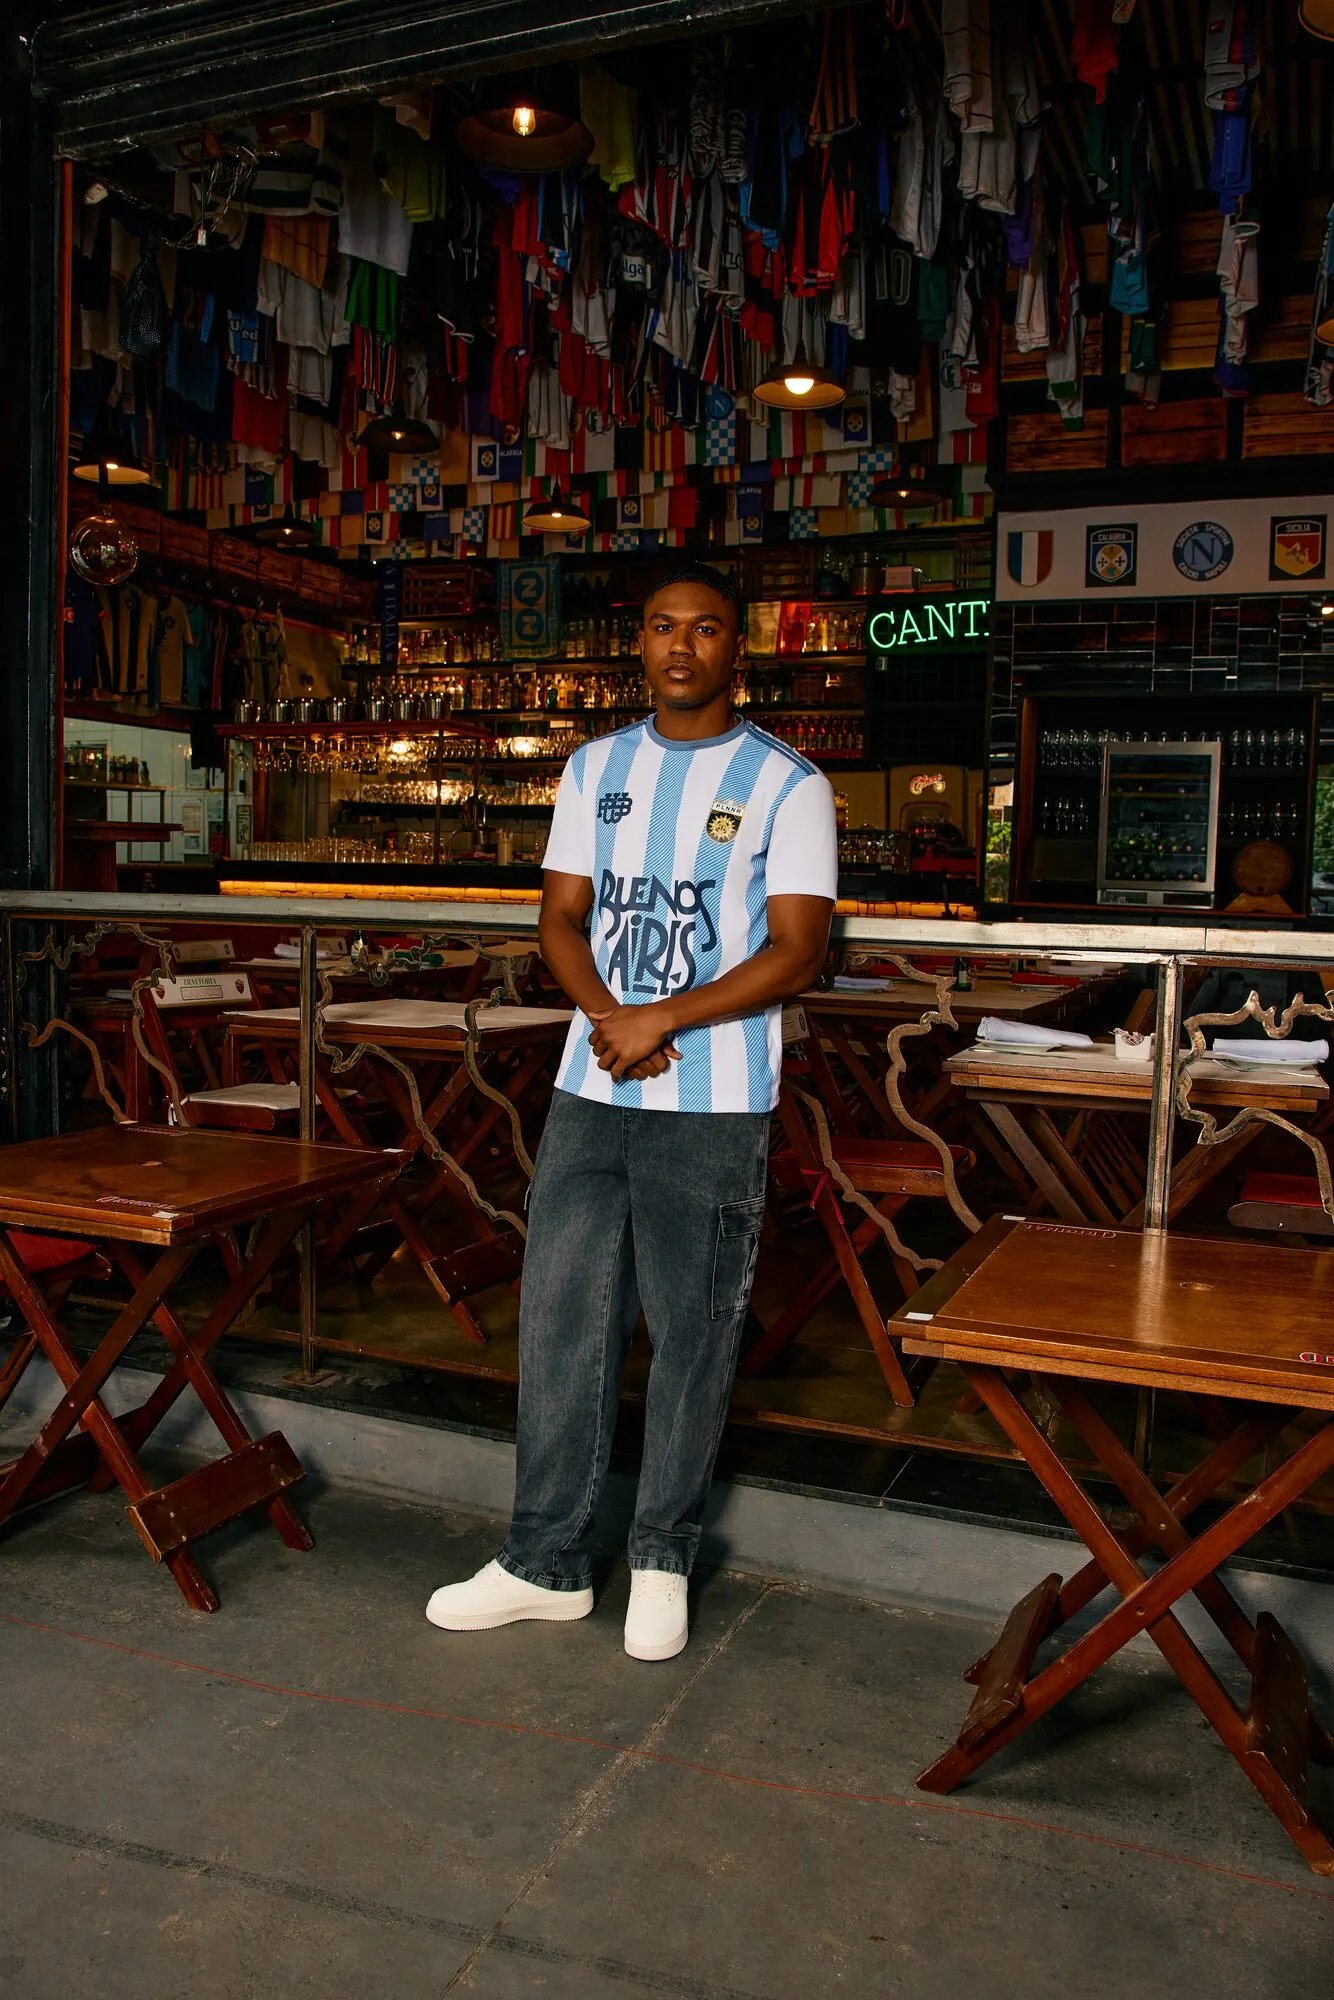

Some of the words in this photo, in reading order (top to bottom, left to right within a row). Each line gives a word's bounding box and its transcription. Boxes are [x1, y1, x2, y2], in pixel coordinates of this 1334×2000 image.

[1097, 532, 1127, 541] CALABRIA
[1205, 523, 1231, 546] SPORTIVA
[1285, 523, 1312, 533] SICILIA
[1190, 538, 1217, 565] N
[869, 600, 992, 649] CANT
[715, 803, 742, 815] PLNNR
[598, 868, 718, 954] BUENOS
[183, 977, 217, 987] TRATTORIA
